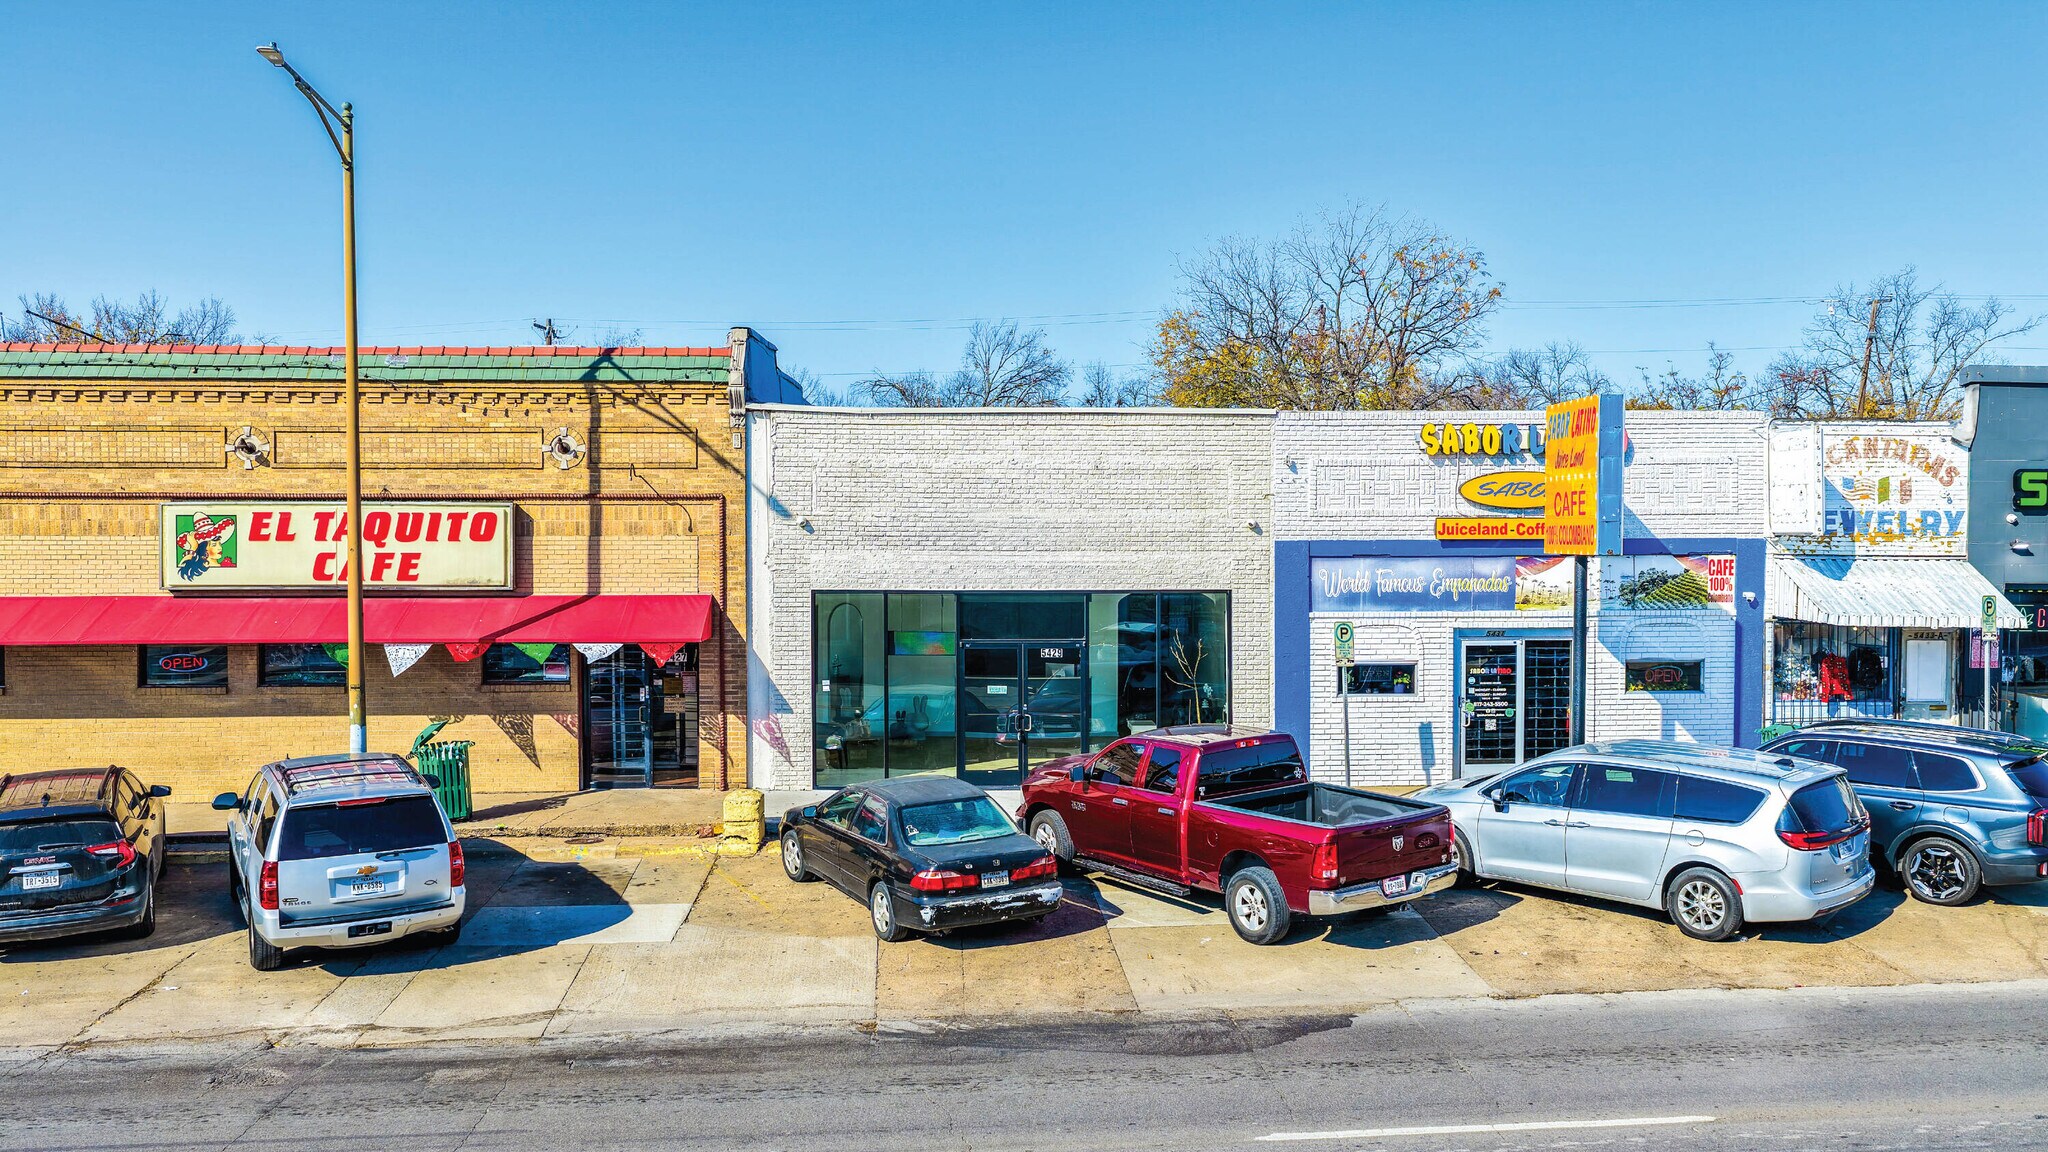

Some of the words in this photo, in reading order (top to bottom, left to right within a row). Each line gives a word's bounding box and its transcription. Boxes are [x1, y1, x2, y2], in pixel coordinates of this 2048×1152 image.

[1548, 411, 1570, 441] SABOR
[1571, 406, 1597, 439] LATINO
[1420, 422, 1521, 456] SABOR
[1555, 448, 1569, 469] Juice
[1570, 444, 1585, 468] Land
[1477, 481, 1545, 498] SABO
[1554, 484, 1586, 517] CAFÉ
[248, 511, 296, 542] EL
[1824, 510, 1965, 537] EWELRY
[1558, 524, 1595, 545] COLOMBIANO
[1708, 558, 1735, 576] CAFE
[1319, 568, 1371, 598] World
[1376, 568, 1427, 597] Famous
[1430, 567, 1512, 601] Empanadas
[1709, 577, 1733, 592] 100%
[1986, 601, 1993, 614] P
[1340, 627, 1349, 639] P
[1041, 648, 1063, 658] 5429
[161, 657, 203, 670] OPEN
[1645, 668, 1681, 682] OPEN
